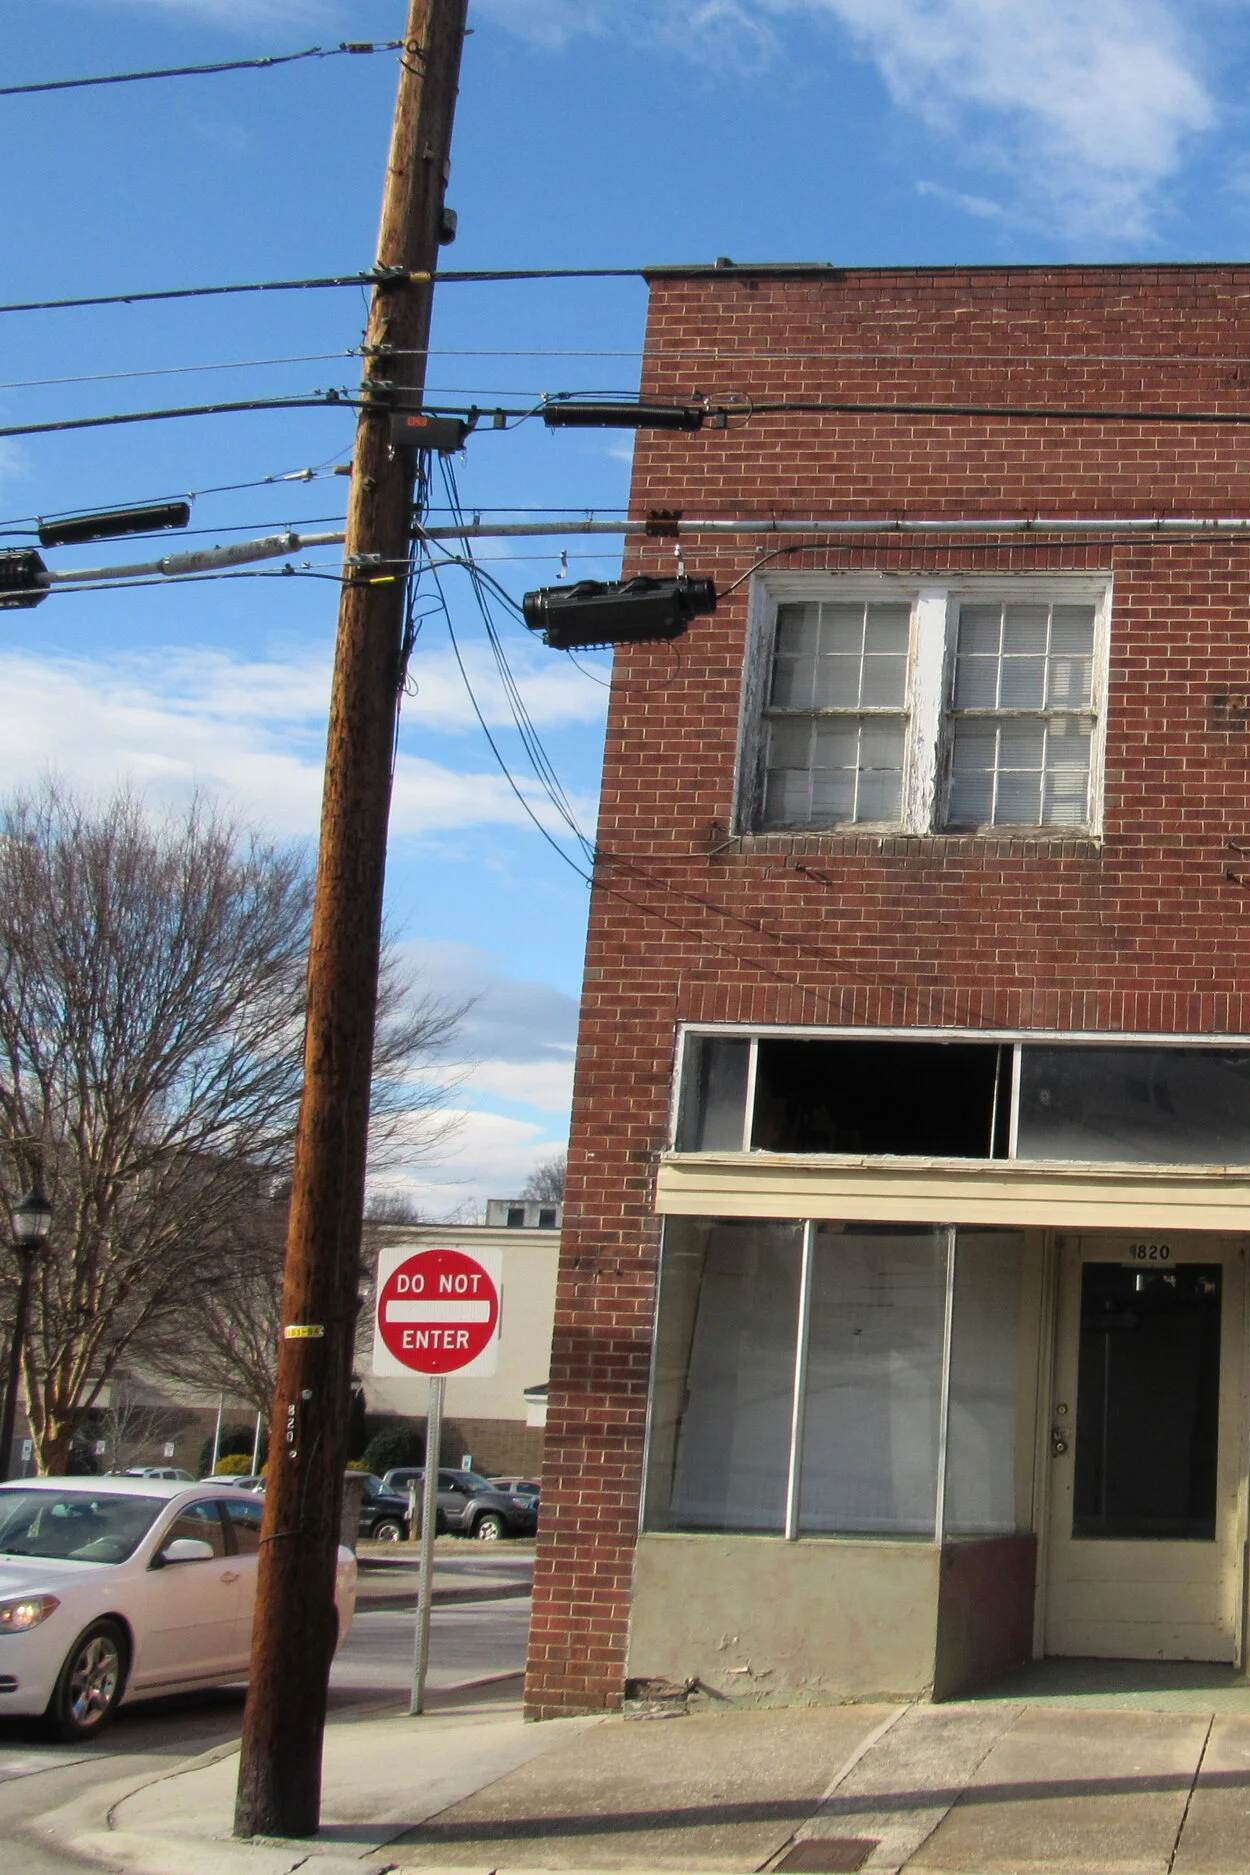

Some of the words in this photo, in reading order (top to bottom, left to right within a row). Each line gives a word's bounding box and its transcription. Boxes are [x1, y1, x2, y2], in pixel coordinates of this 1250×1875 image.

[397, 1274, 425, 1293] DO
[439, 1274, 482, 1293] NOT
[402, 1330, 470, 1349] ENTER
